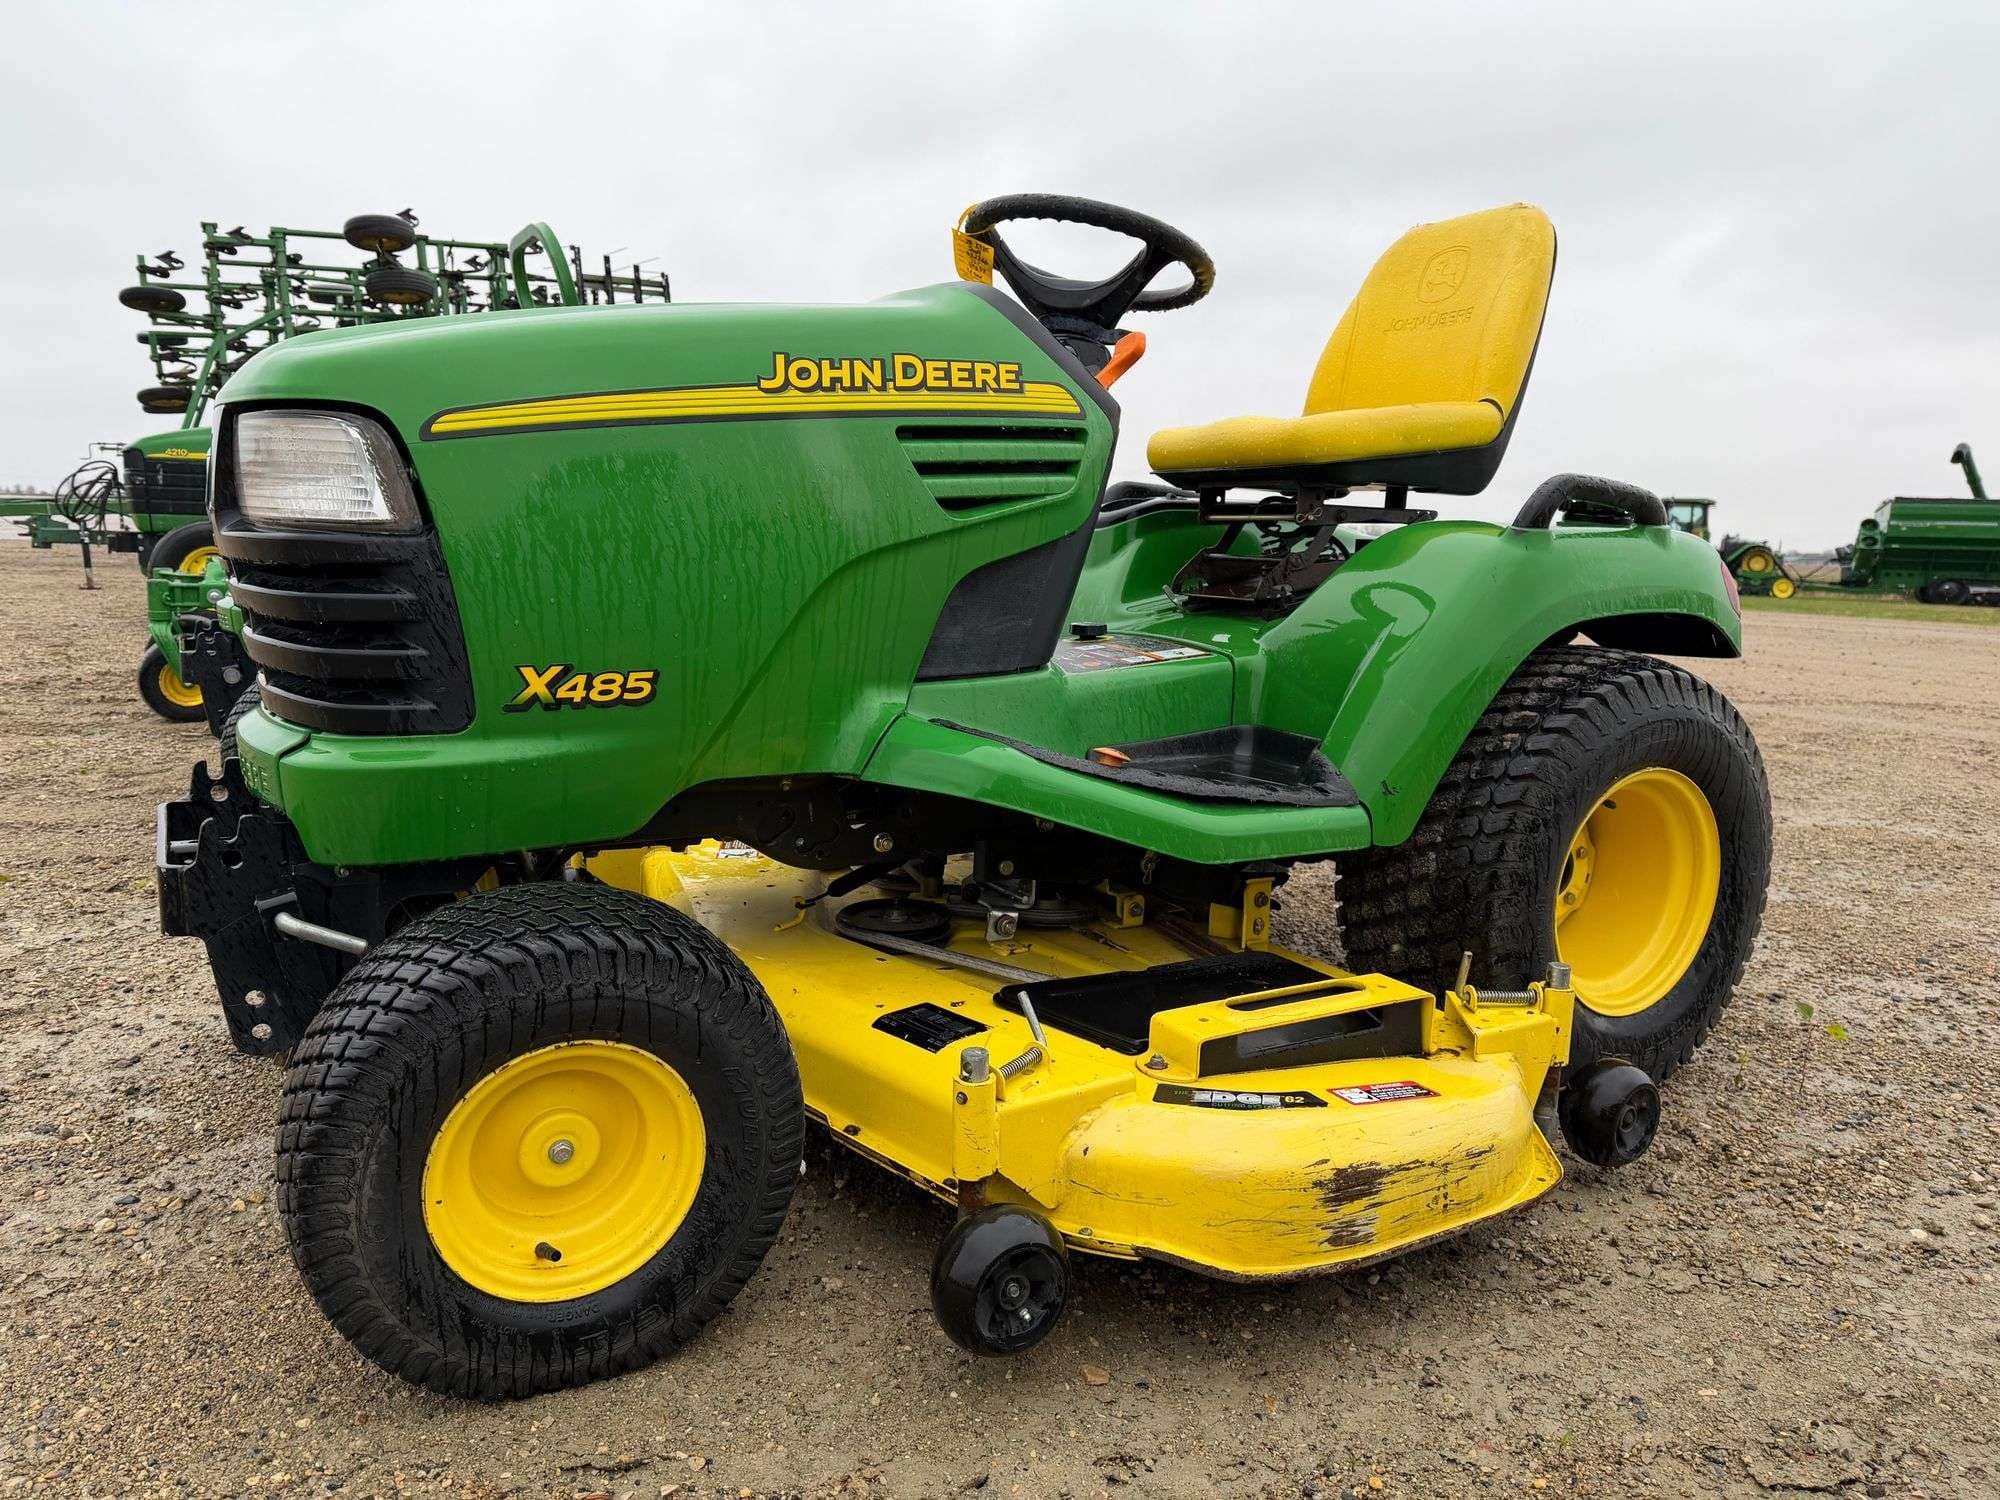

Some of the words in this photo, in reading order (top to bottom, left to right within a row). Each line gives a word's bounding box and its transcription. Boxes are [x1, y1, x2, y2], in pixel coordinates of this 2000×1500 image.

[757, 352, 884, 393] JOHN
[892, 353, 1024, 394] DEERE
[503, 663, 659, 711] X485
